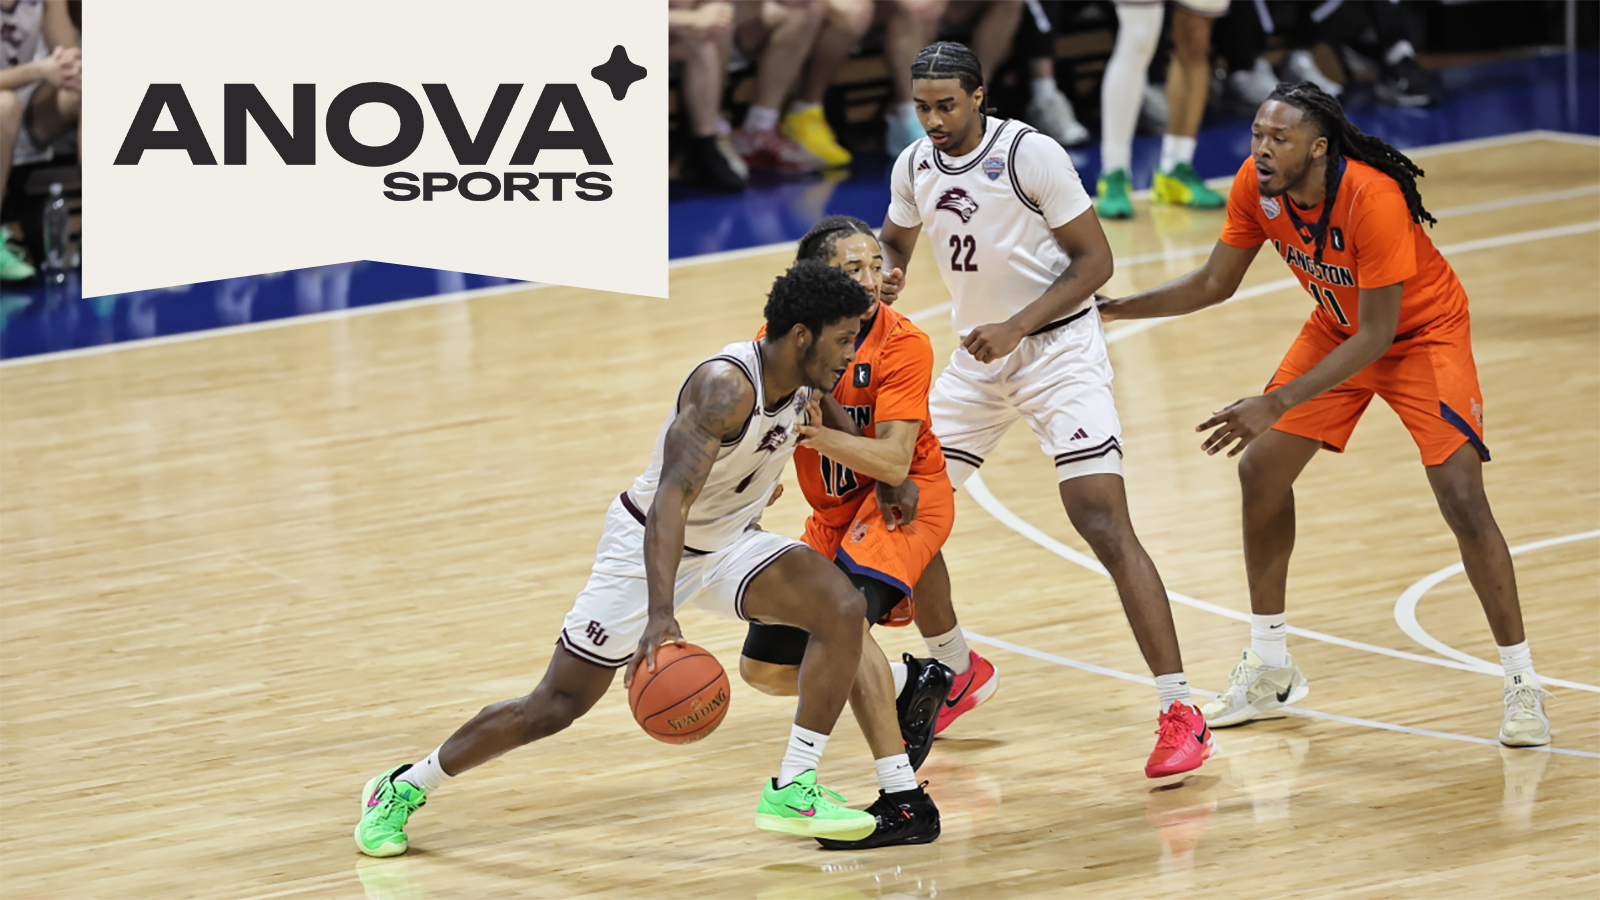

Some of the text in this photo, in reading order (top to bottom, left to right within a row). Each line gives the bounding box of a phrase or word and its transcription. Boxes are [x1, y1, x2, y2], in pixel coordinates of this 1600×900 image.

[949, 235, 978, 272] 22
[1308, 281, 1351, 327] 11
[818, 452, 860, 498] 10
[585, 619, 610, 647] FHU
[667, 687, 728, 732] SPALDING
